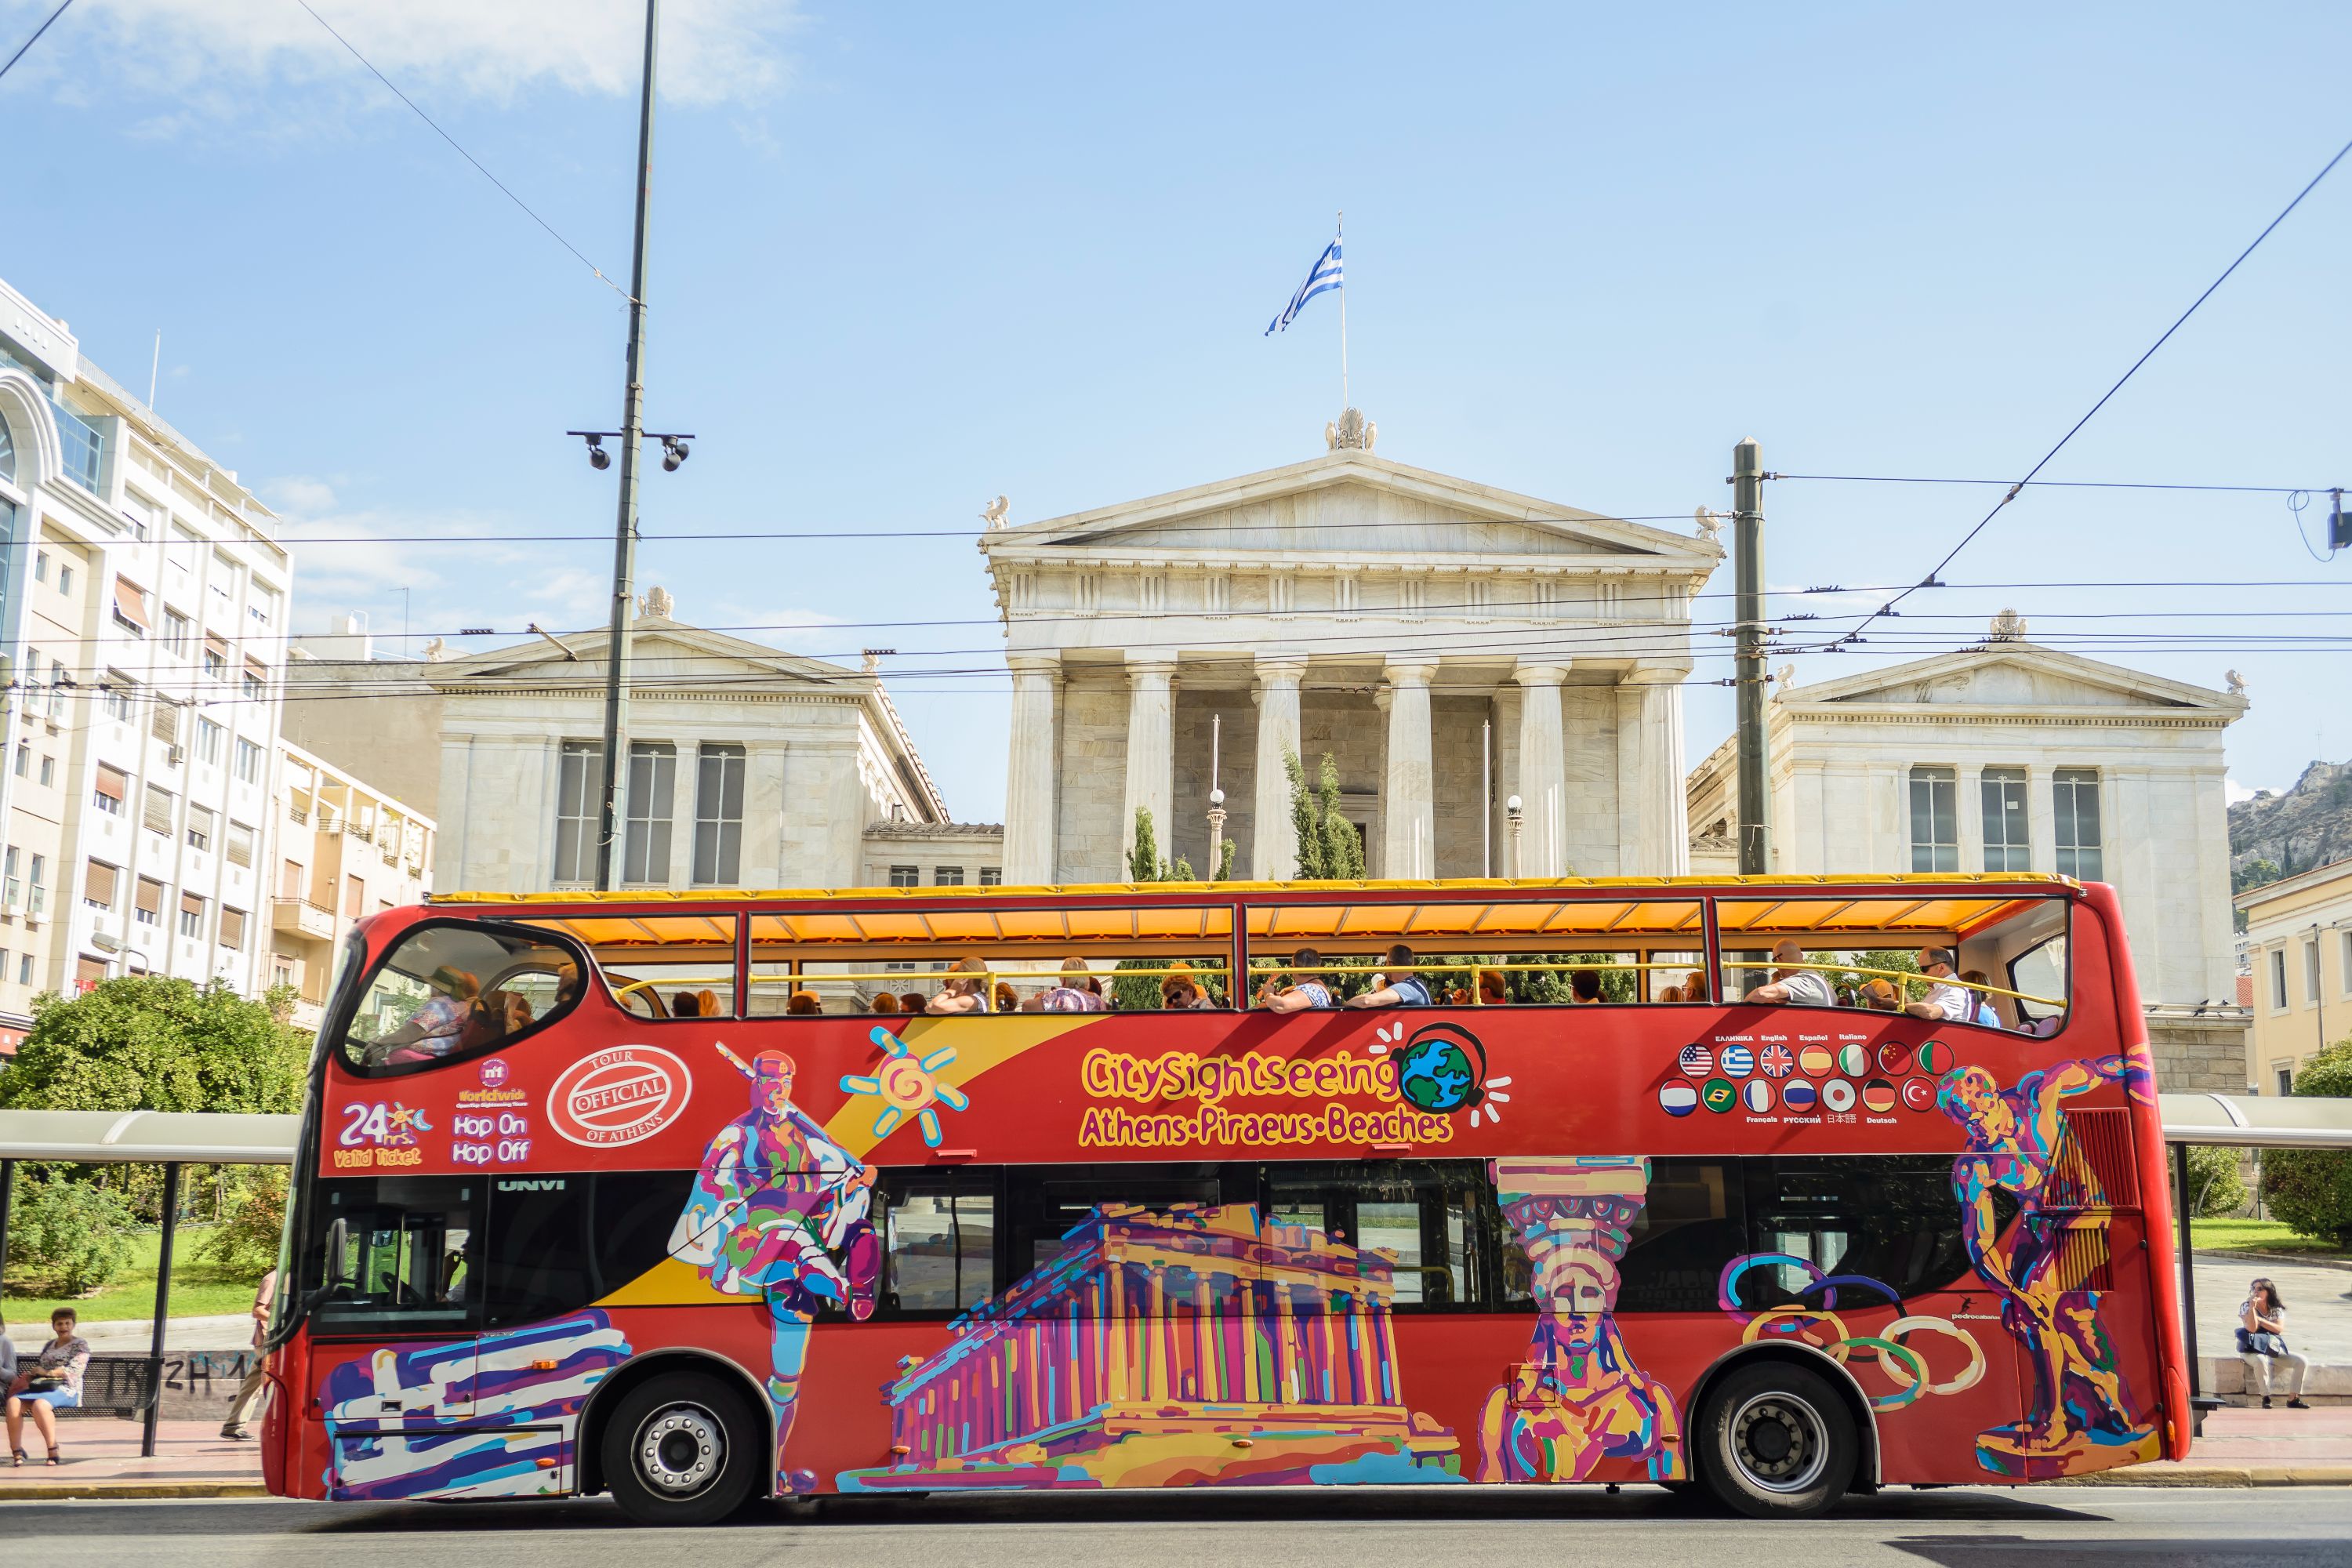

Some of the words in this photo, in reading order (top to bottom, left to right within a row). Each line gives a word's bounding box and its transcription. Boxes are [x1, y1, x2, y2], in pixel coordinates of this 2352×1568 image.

[588, 1051, 633, 1070] TOUR
[1083, 1049, 1400, 1102] CitySightseeing
[575, 1078, 664, 1112] OFFICIAL
[340, 1104, 389, 1145] 24
[454, 1116, 495, 1138] Hop
[499, 1112, 527, 1134] On
[586, 1130, 606, 1142] OF
[608, 1113, 664, 1142] ATHENS
[1081, 1109, 1186, 1145] Athens
[1200, 1106, 1314, 1144] Piraeus
[1327, 1105, 1451, 1143] Beaches
[1783, 1114, 1821, 1123] РУССКИЙ
[1827, 1113, 1857, 1124] 日本語
[333, 1149, 374, 1167] Valid
[375, 1147, 423, 1167] Ticket
[452, 1142, 493, 1165] Hop
[497, 1140, 531, 1162] Off
[497, 1180, 566, 1192] UNVI
